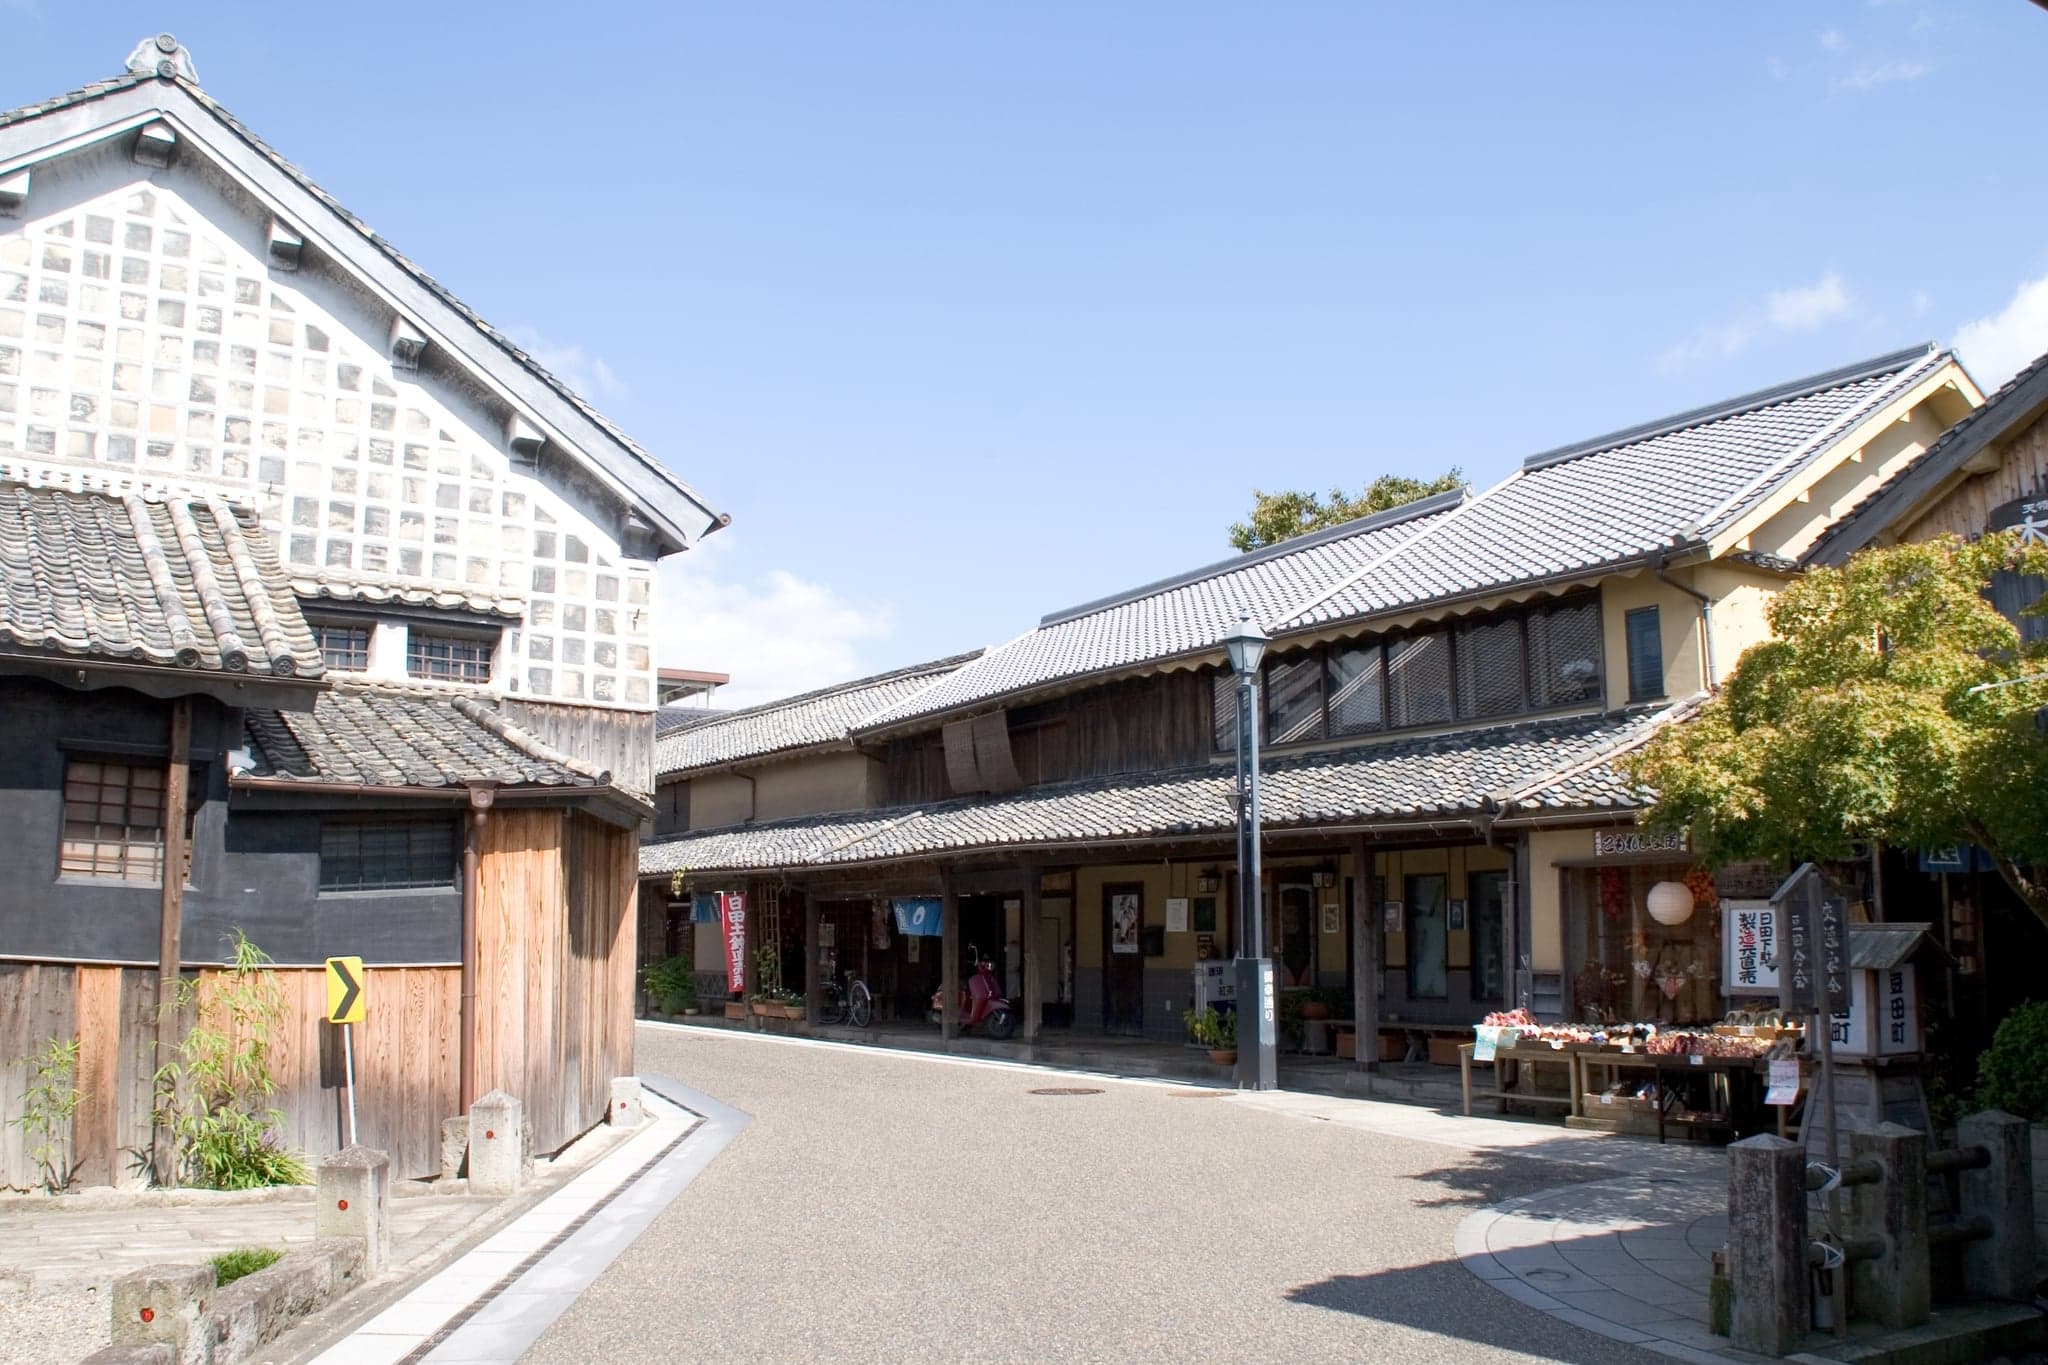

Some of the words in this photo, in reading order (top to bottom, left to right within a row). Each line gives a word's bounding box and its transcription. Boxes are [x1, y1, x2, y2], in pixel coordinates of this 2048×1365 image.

[1738, 911, 1757, 984] 製造元直売
[1885, 971, 1905, 1044] 豆田町
